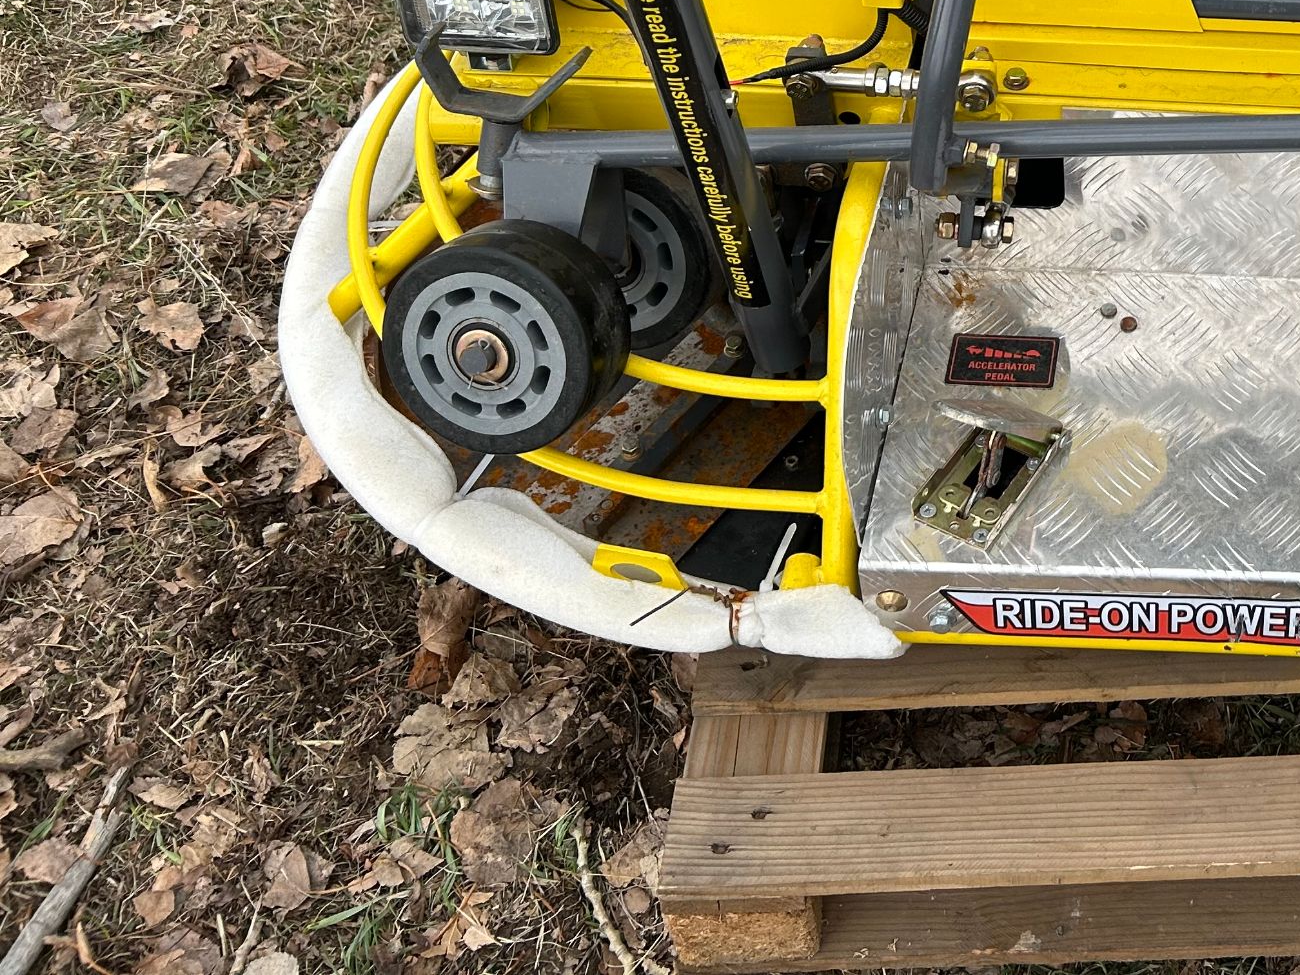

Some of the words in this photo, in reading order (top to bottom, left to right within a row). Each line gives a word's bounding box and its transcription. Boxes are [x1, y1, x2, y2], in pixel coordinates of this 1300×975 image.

[642, 6, 678, 44] read
[656, 46, 683, 75] the
[666, 76, 710, 164] instructions
[696, 165, 733, 224] carefully
[715, 224, 743, 266] before
[730, 266, 754, 300] using
[968, 360, 1037, 373] ACCELERATOR
[984, 371, 1017, 383] PEDAL
[993, 598, 1159, 634] RIDE-ON
